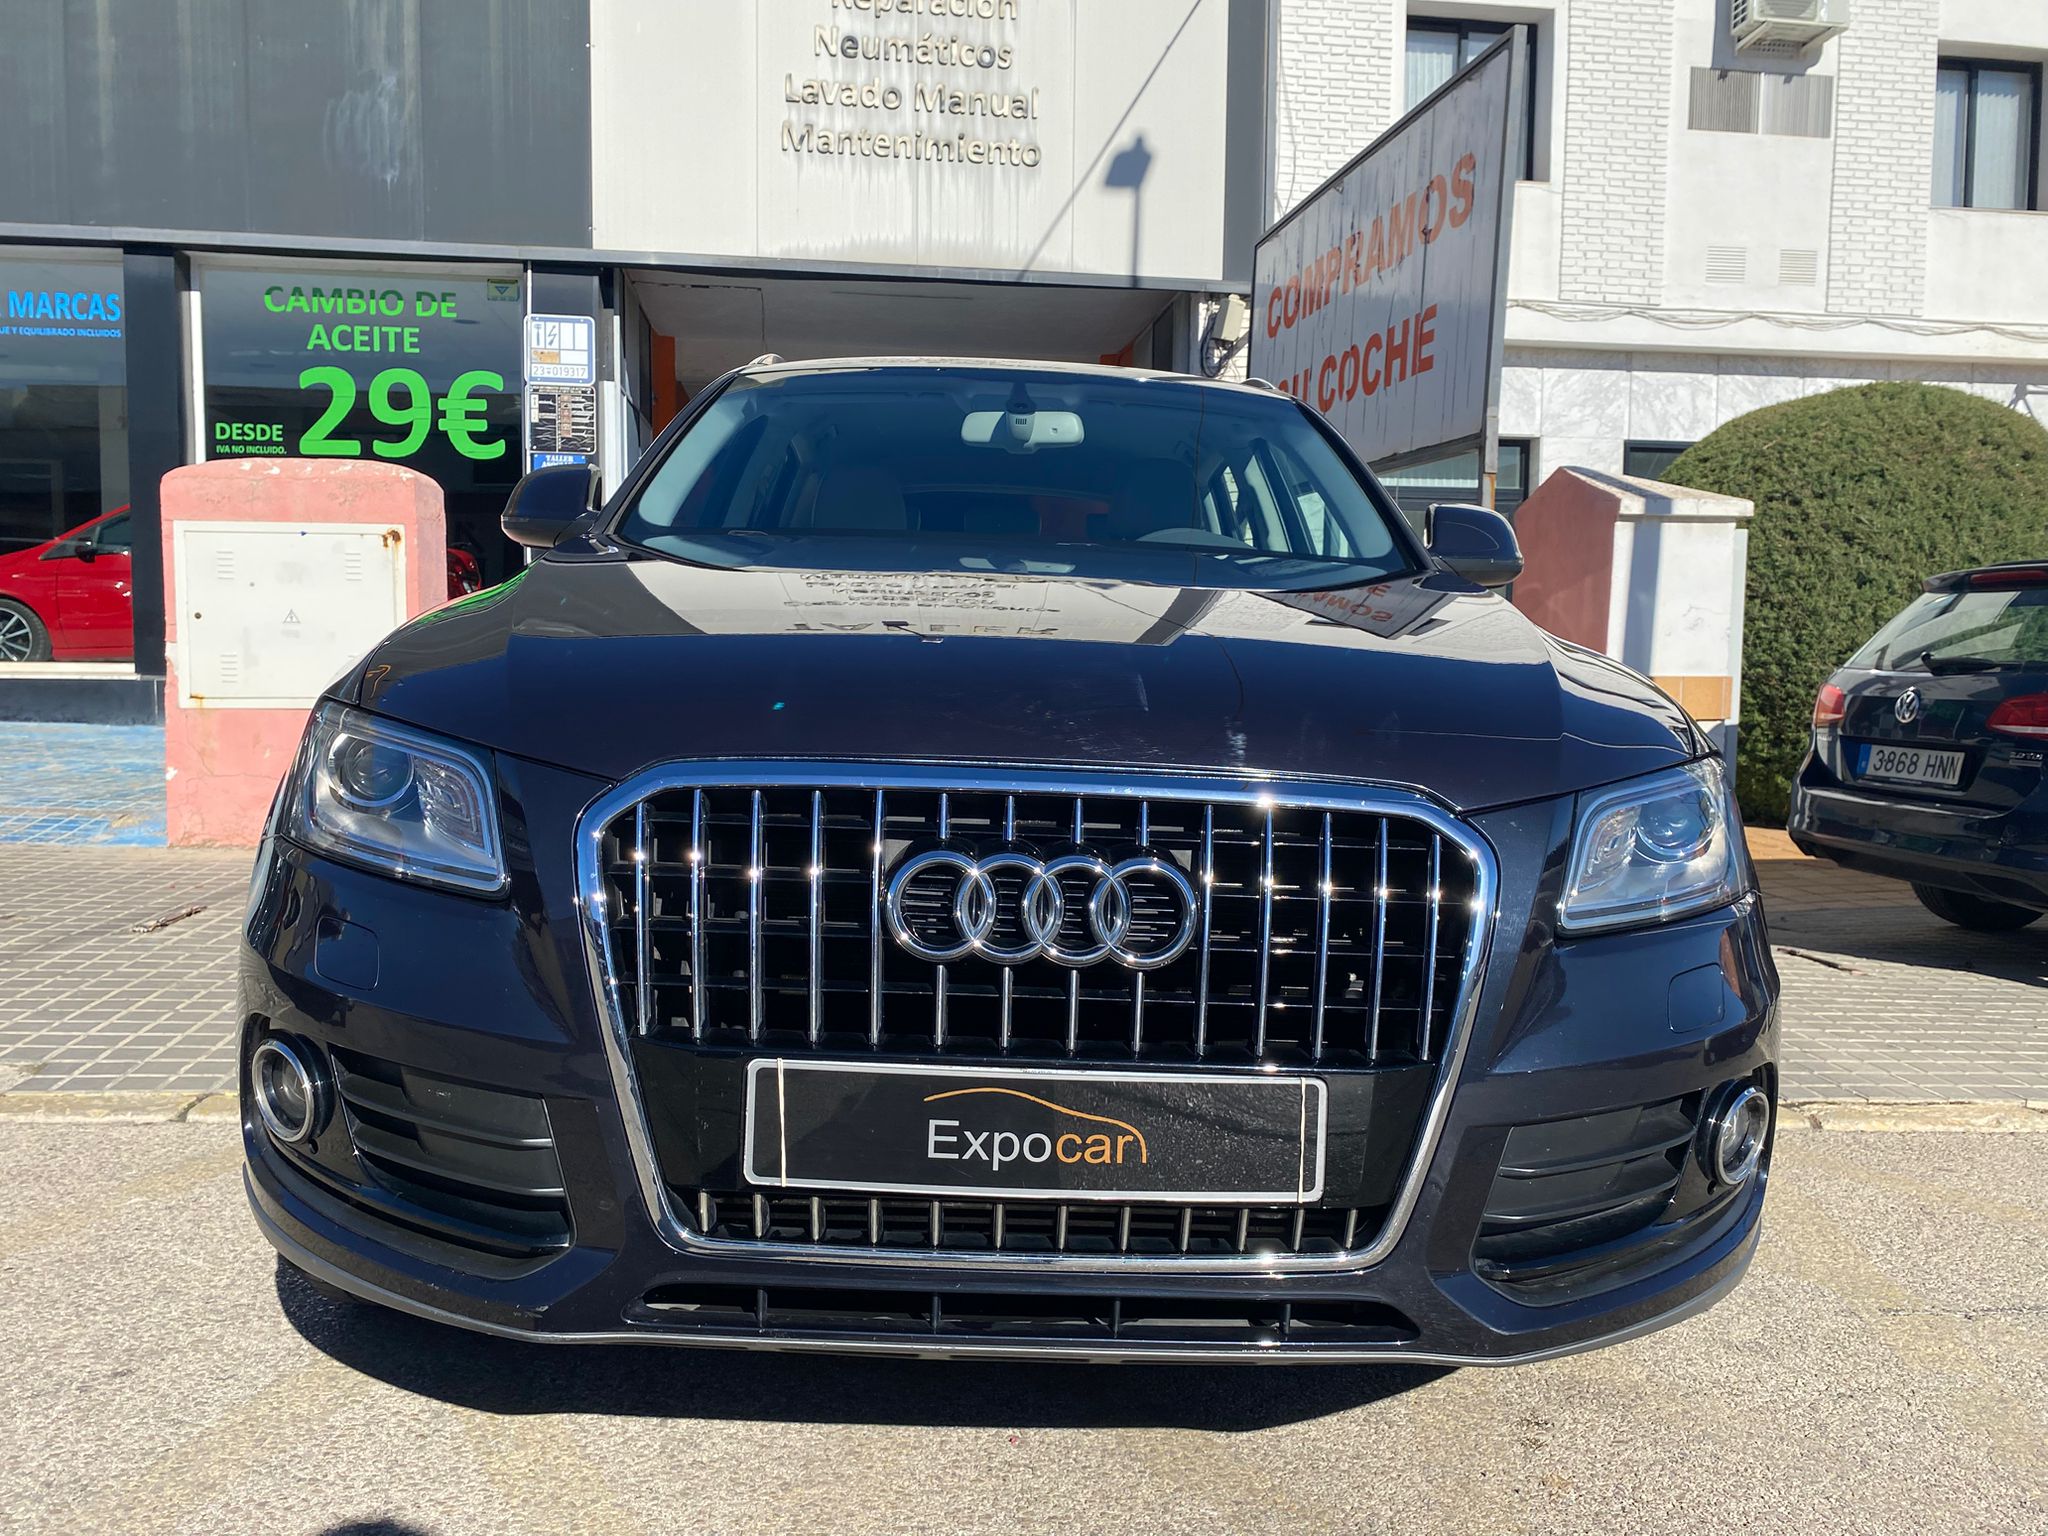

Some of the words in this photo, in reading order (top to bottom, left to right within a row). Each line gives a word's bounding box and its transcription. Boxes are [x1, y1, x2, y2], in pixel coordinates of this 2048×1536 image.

[814, 24, 1013, 69] Neumáticos
[785, 73, 902, 110] Lavado
[914, 82, 1039, 119] Manual
[781, 120, 1042, 167] Mantenimiento
[1266, 152, 1477, 338] COMPRAMOS
[8, 290, 121, 321] MARCAS
[264, 285, 404, 316] CAMBIO
[415, 291, 458, 318] DE
[307, 324, 421, 353] ACEITE
[1317, 303, 1438, 413] COCHE
[215, 422, 284, 442] DESDE
[300, 366, 506, 460] 29€
[216, 445, 230, 454] IVA
[231, 445, 245, 454] NO
[1873, 749, 1920, 775] 3868
[1923, 754, 1960, 779] HNN
[927, 1119, 1135, 1172] Expocar
